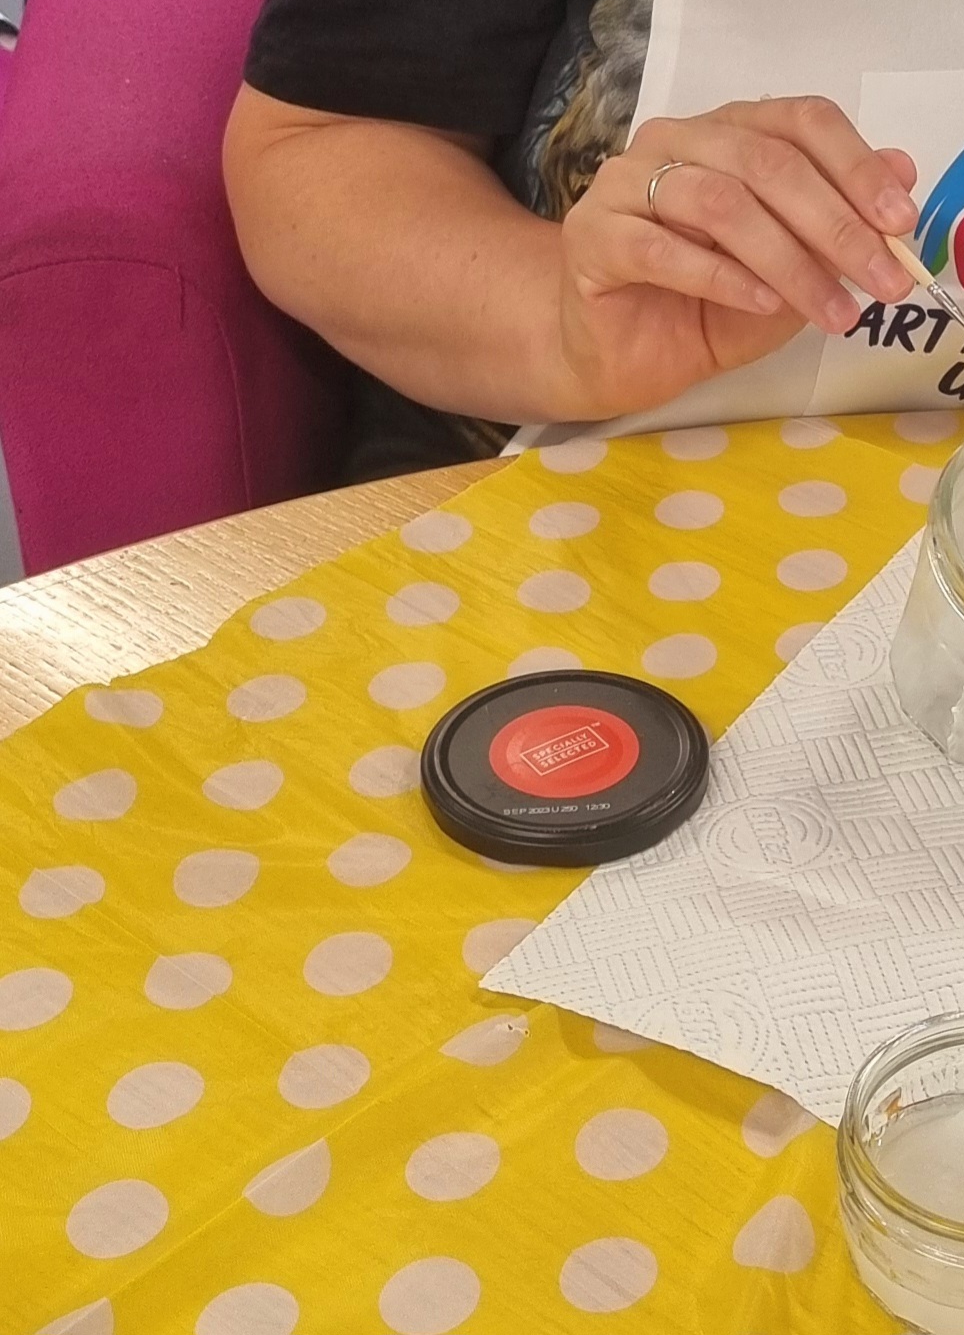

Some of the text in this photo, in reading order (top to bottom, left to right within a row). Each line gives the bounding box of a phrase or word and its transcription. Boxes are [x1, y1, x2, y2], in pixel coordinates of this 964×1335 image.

[844, 301, 956, 354] ART
[531, 732, 588, 761] SPECIALLY
[539, 740, 597, 768] SELECTED
